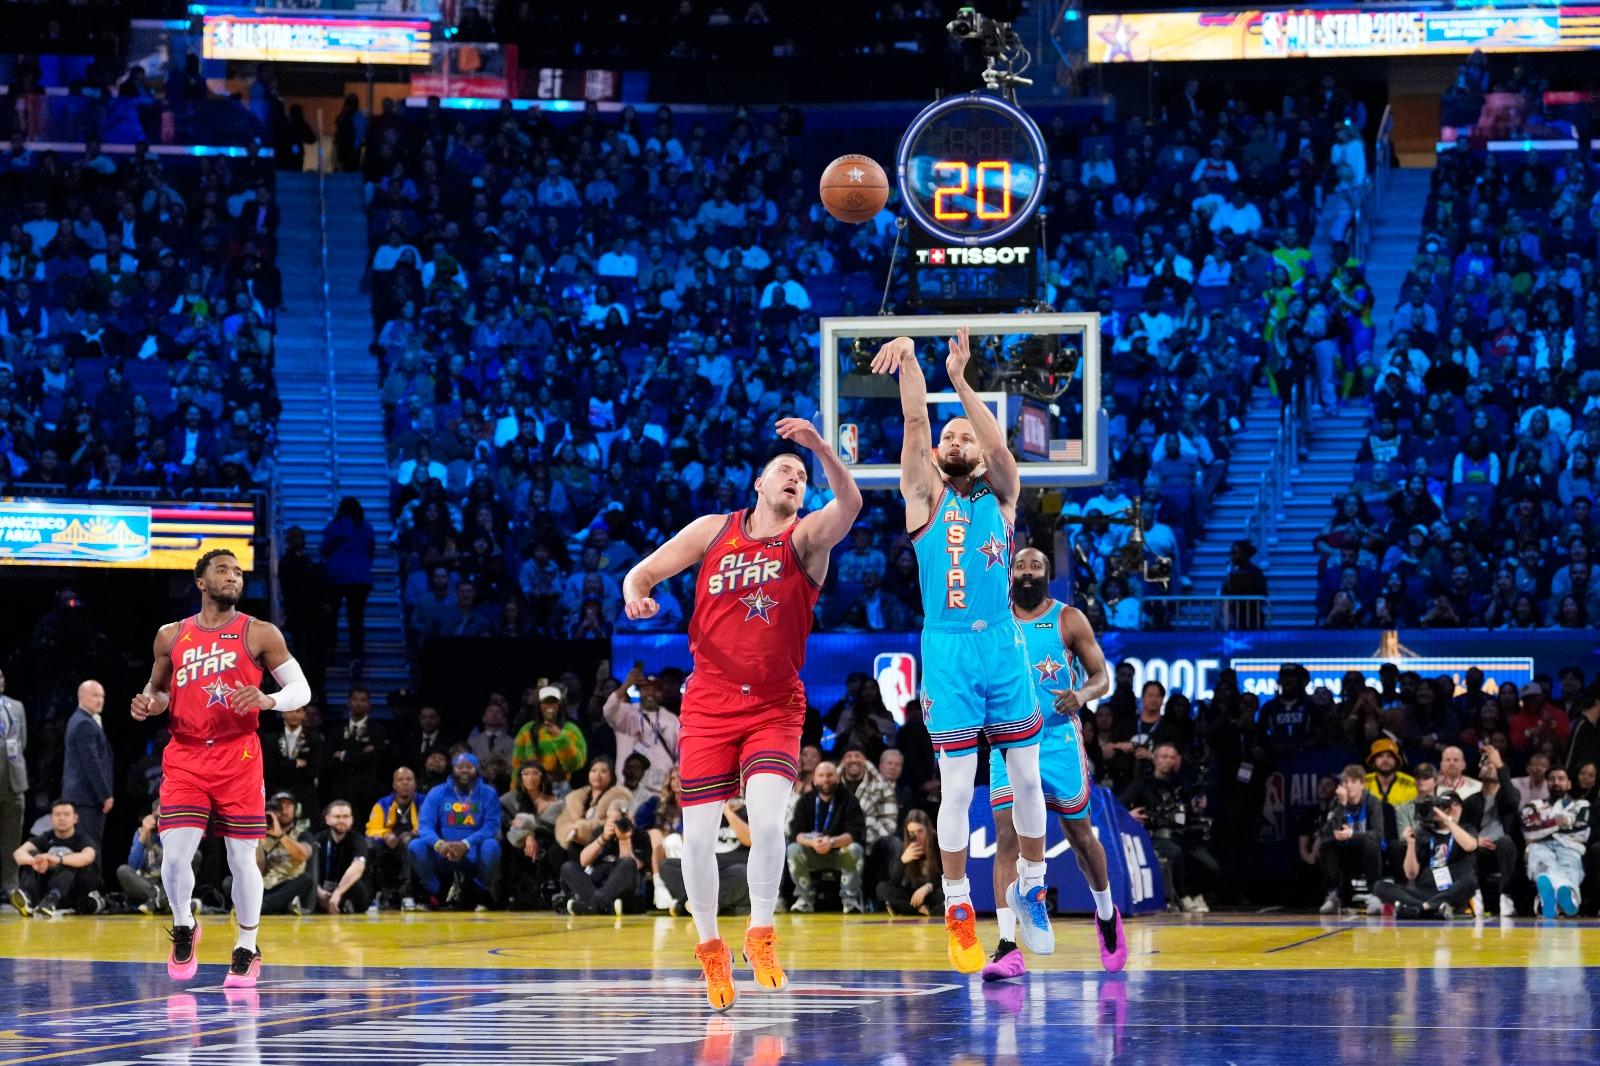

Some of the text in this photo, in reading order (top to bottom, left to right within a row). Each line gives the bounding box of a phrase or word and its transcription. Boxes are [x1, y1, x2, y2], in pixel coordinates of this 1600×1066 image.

[935, 161, 1010, 219] 20
[946, 247, 1030, 265] TISSOT
[0, 516, 67, 531] ANCISCO
[944, 510, 970, 524] ALL
[719, 551, 768, 571] ALL
[946, 524, 967, 609] STAR
[708, 559, 782, 595] STAR
[182, 641, 225, 666] ALL
[176, 651, 237, 687] STAR
